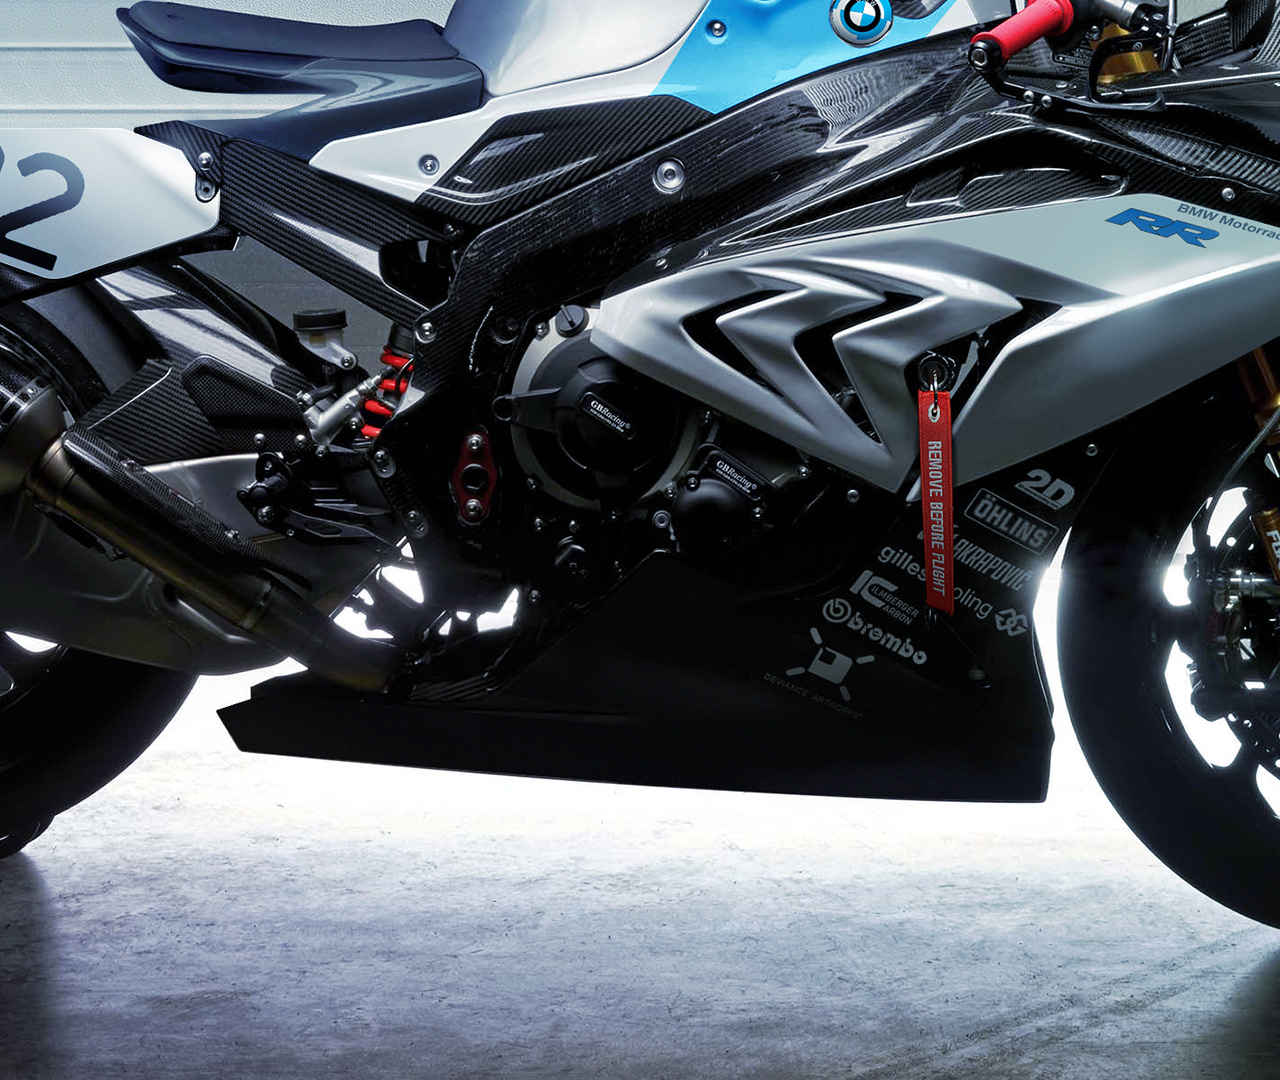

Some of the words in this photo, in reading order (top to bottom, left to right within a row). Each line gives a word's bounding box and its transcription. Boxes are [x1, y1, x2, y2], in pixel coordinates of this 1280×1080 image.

[1105, 207, 1220, 249] RR
[1176, 203, 1220, 222] BMW
[927, 440, 944, 498] REMOVE
[1014, 468, 1076, 511] 2D
[929, 502, 946, 553] BEFORE
[973, 494, 1048, 548] ÖHLINS
[931, 553, 946, 597] FLIGHT
[953, 586, 995, 620] oling
[846, 611, 928, 665] brembo
[763, 672, 810, 698] DEVIANCE
